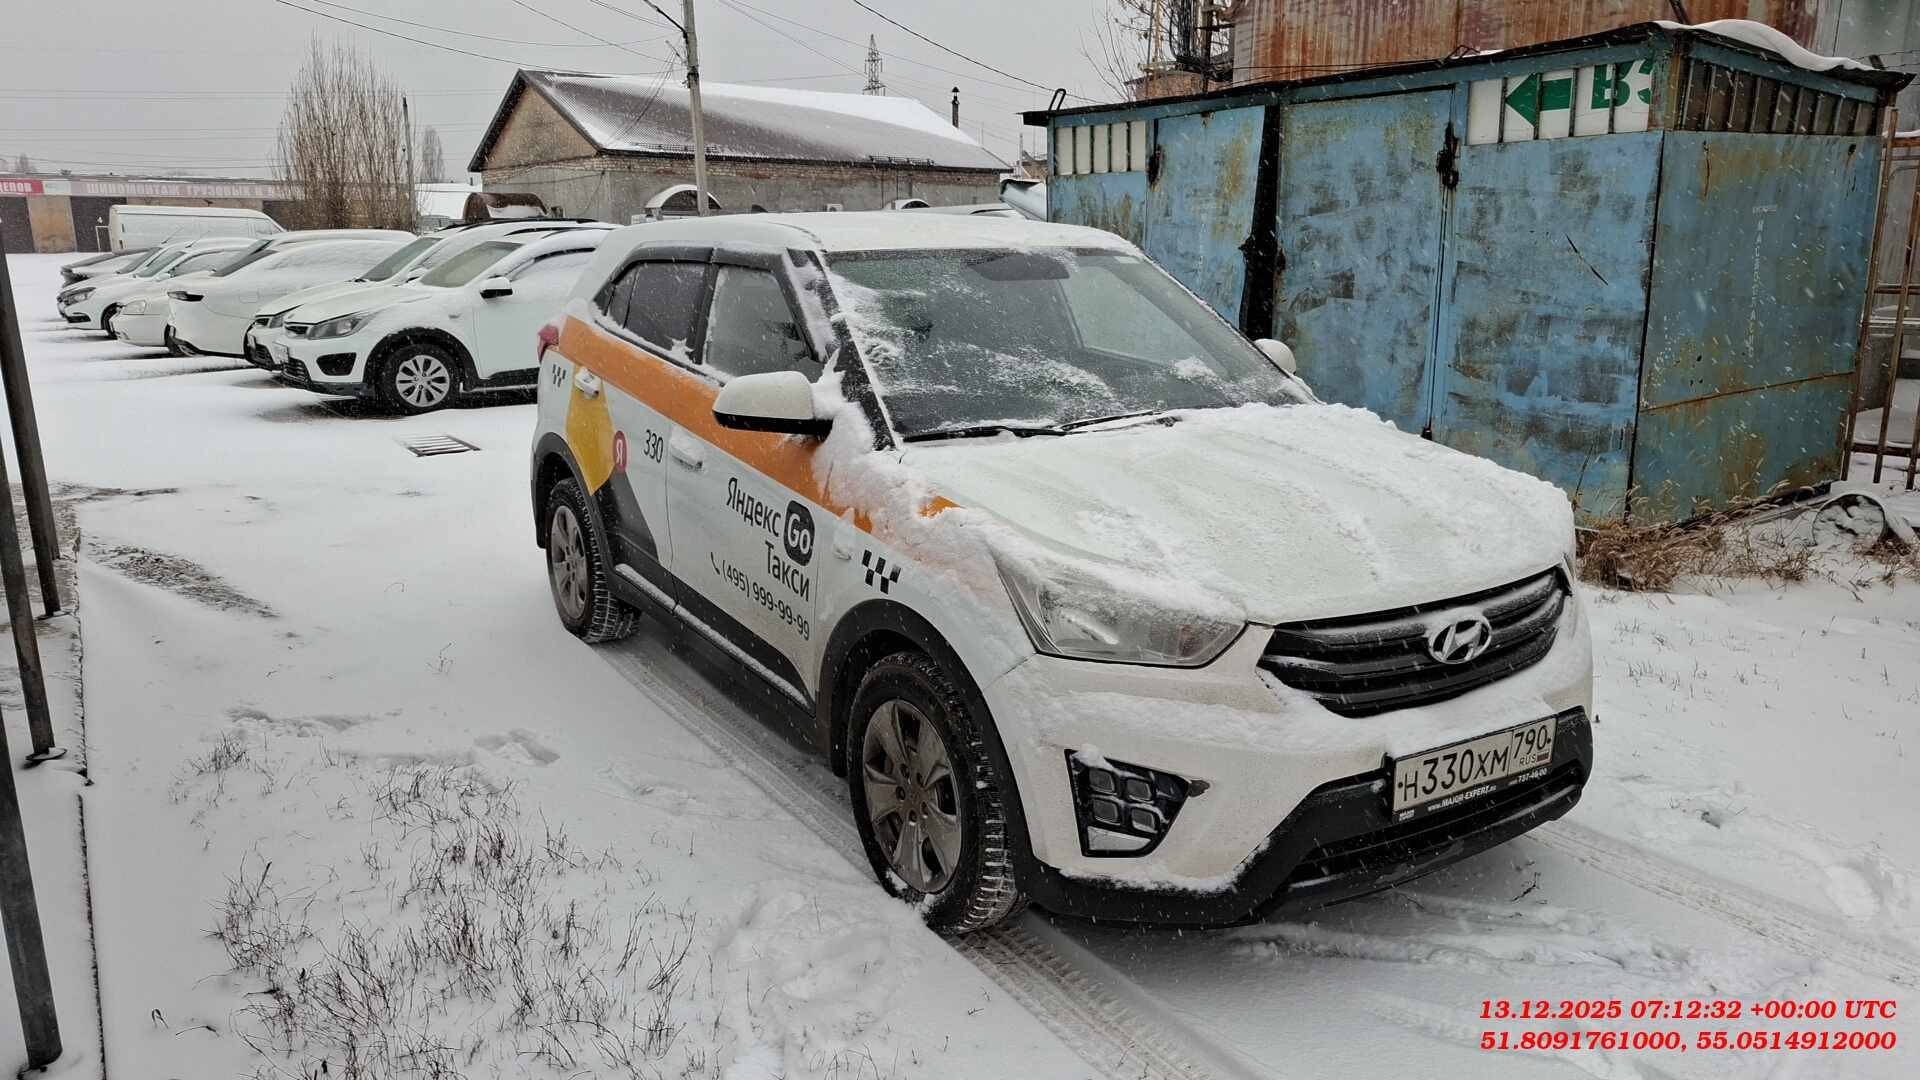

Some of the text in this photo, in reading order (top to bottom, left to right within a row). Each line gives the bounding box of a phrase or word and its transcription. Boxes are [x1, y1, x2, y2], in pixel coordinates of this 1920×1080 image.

[643, 429, 663, 463] 330
[726, 477, 811, 555] Яндекс Go
[765, 540, 810, 602] Такси
[722, 560, 810, 641] (495) 999-99-99
[1514, 724, 1548, 759] 790
[1519, 754, 1537, 766] RUS
